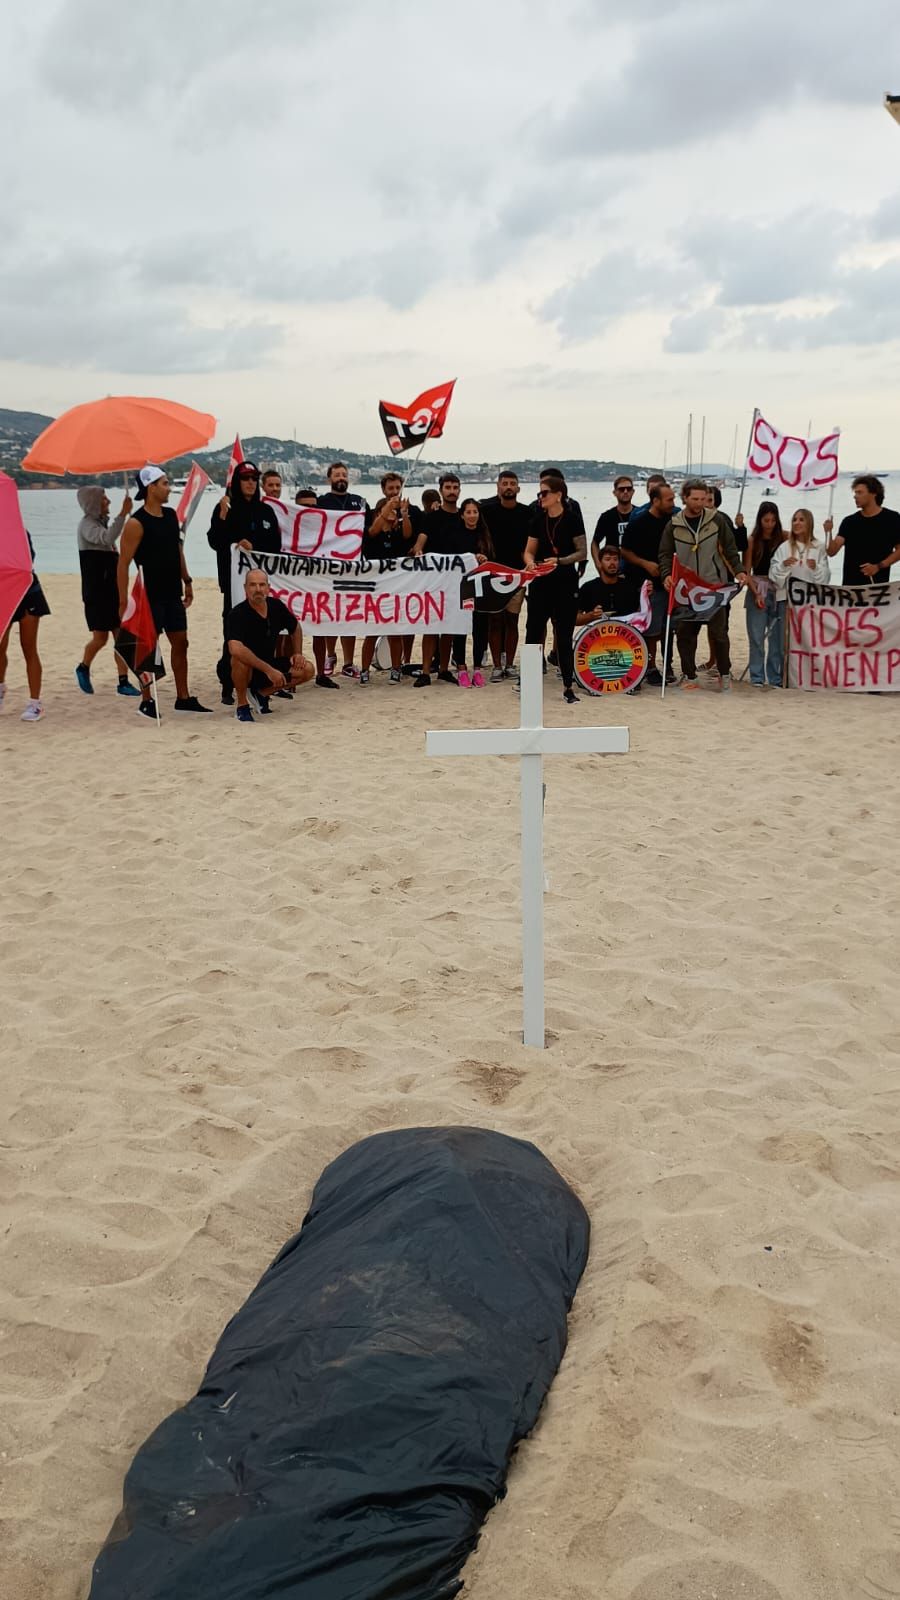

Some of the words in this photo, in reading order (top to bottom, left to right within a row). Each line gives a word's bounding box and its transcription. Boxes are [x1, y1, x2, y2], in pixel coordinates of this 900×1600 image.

[749, 418, 840, 488] S.O.S
[379, 558, 397, 575] DE
[401, 554, 466, 574] CALVIA
[269, 586, 445, 625] CARIZACION
[674, 578, 738, 612] CGT
[589, 625, 643, 660] SOCORRISTES
[590, 676, 633, 692] CALVIA
